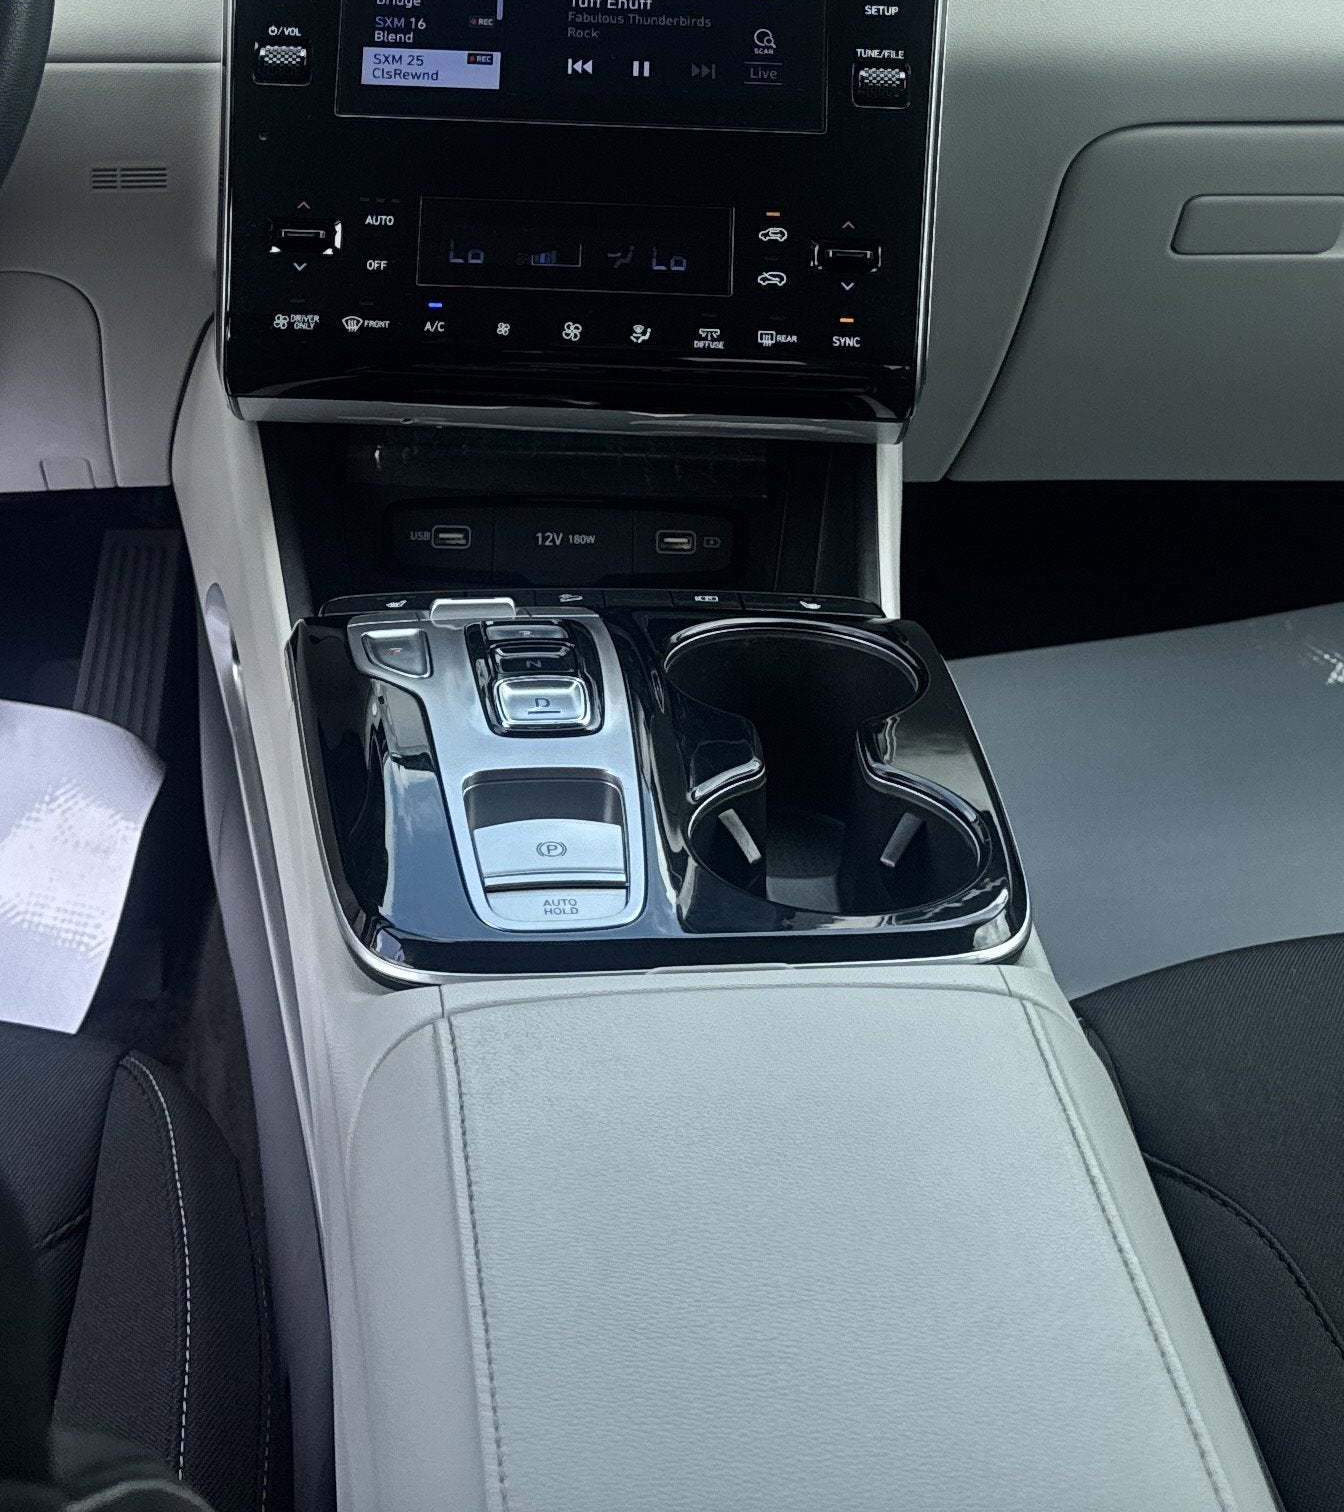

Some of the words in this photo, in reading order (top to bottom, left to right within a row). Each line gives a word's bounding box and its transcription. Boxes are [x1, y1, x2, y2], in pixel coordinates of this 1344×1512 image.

[865, 5, 899, 16] SETUP
[375, 17, 405, 29] SXM
[409, 18, 426, 30] 16
[478, 18, 494, 26] REC
[568, 12, 624, 25] Fabulous
[628, 13, 712, 28] Thunderbirds
[374, 30, 413, 43] Blend
[567, 28, 600, 39] Rock
[476, 55, 491, 63] REC
[856, 48, 905, 60] TUNE/FILE
[373, 54, 403, 65] SXM
[406, 55, 424, 67] 25
[372, 68, 439, 82] ClsRewnd
[750, 68, 777, 80] Live
[365, 215, 394, 226] AUTO
[366, 260, 387, 270] OFF
[290, 315, 319, 323] DRIVER
[364, 320, 390, 329] FRONT
[294, 322, 315, 330] ONLY
[424, 321, 445, 332] A/C
[777, 335, 797, 343] REAR
[832, 336, 861, 347] SYNC
[694, 341, 725, 349] DIFFUSE
[410, 530, 431, 541] USB
[535, 532, 564, 546] 12V
[568, 534, 596, 545] 180W
[535, 698, 550, 708] D
[543, 898, 577, 907] AUTO
[544, 907, 579, 915] HOLD
